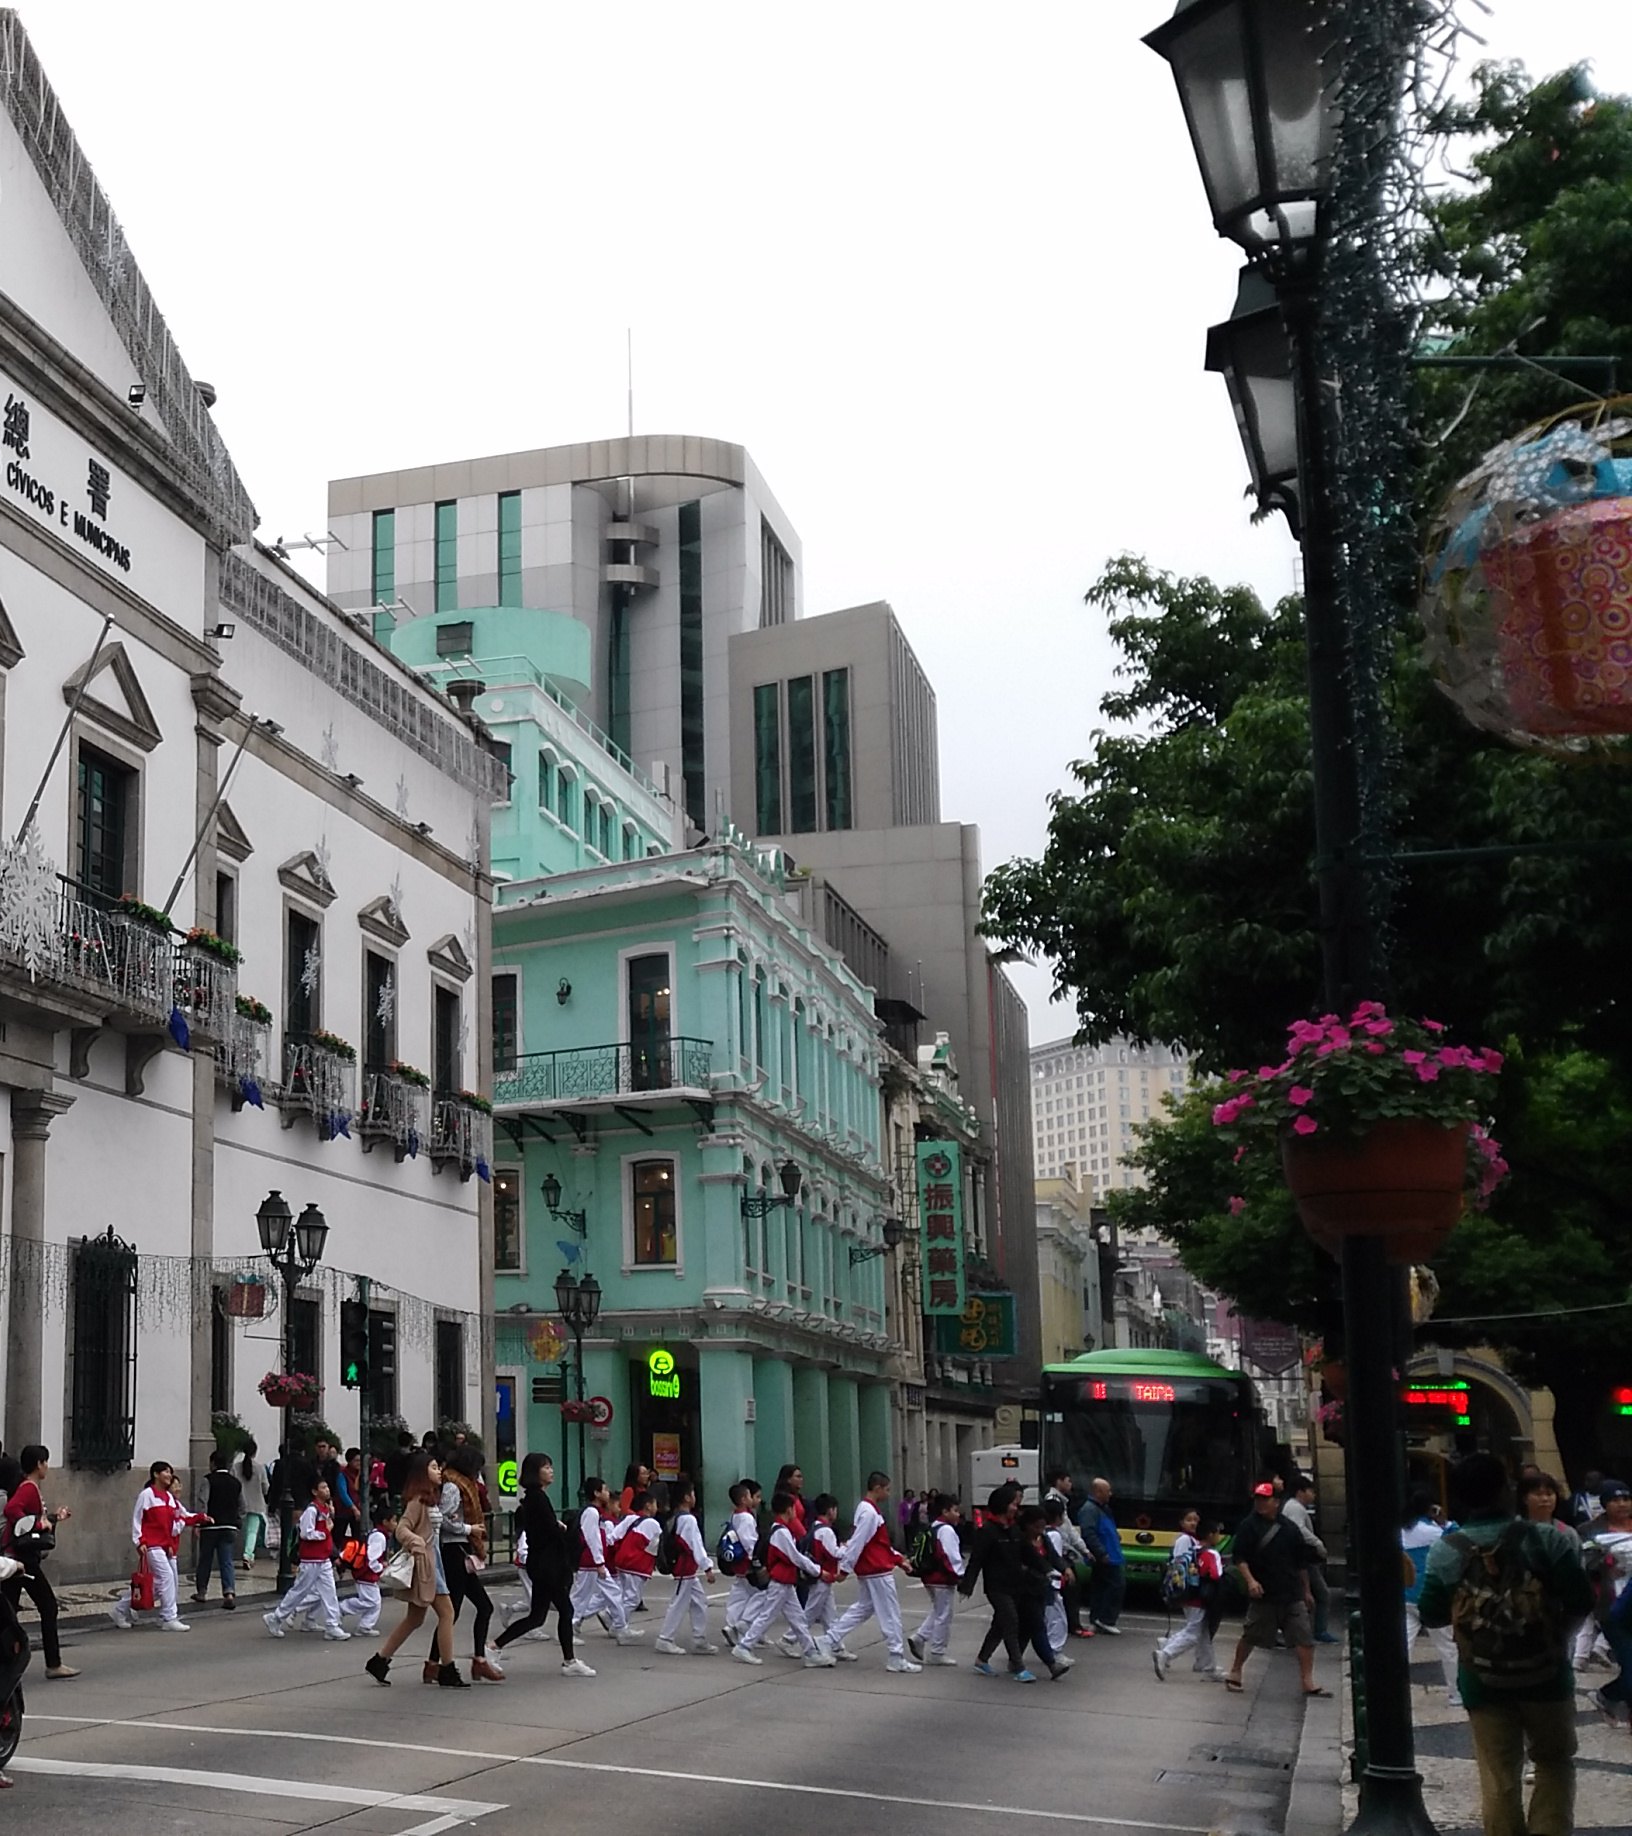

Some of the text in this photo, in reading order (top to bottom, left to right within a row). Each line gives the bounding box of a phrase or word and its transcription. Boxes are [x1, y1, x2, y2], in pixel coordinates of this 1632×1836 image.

[6, 460, 55, 516] CÍVICOS
[60, 500, 69, 527] E
[74, 510, 131, 573] MUNICIPAIS
